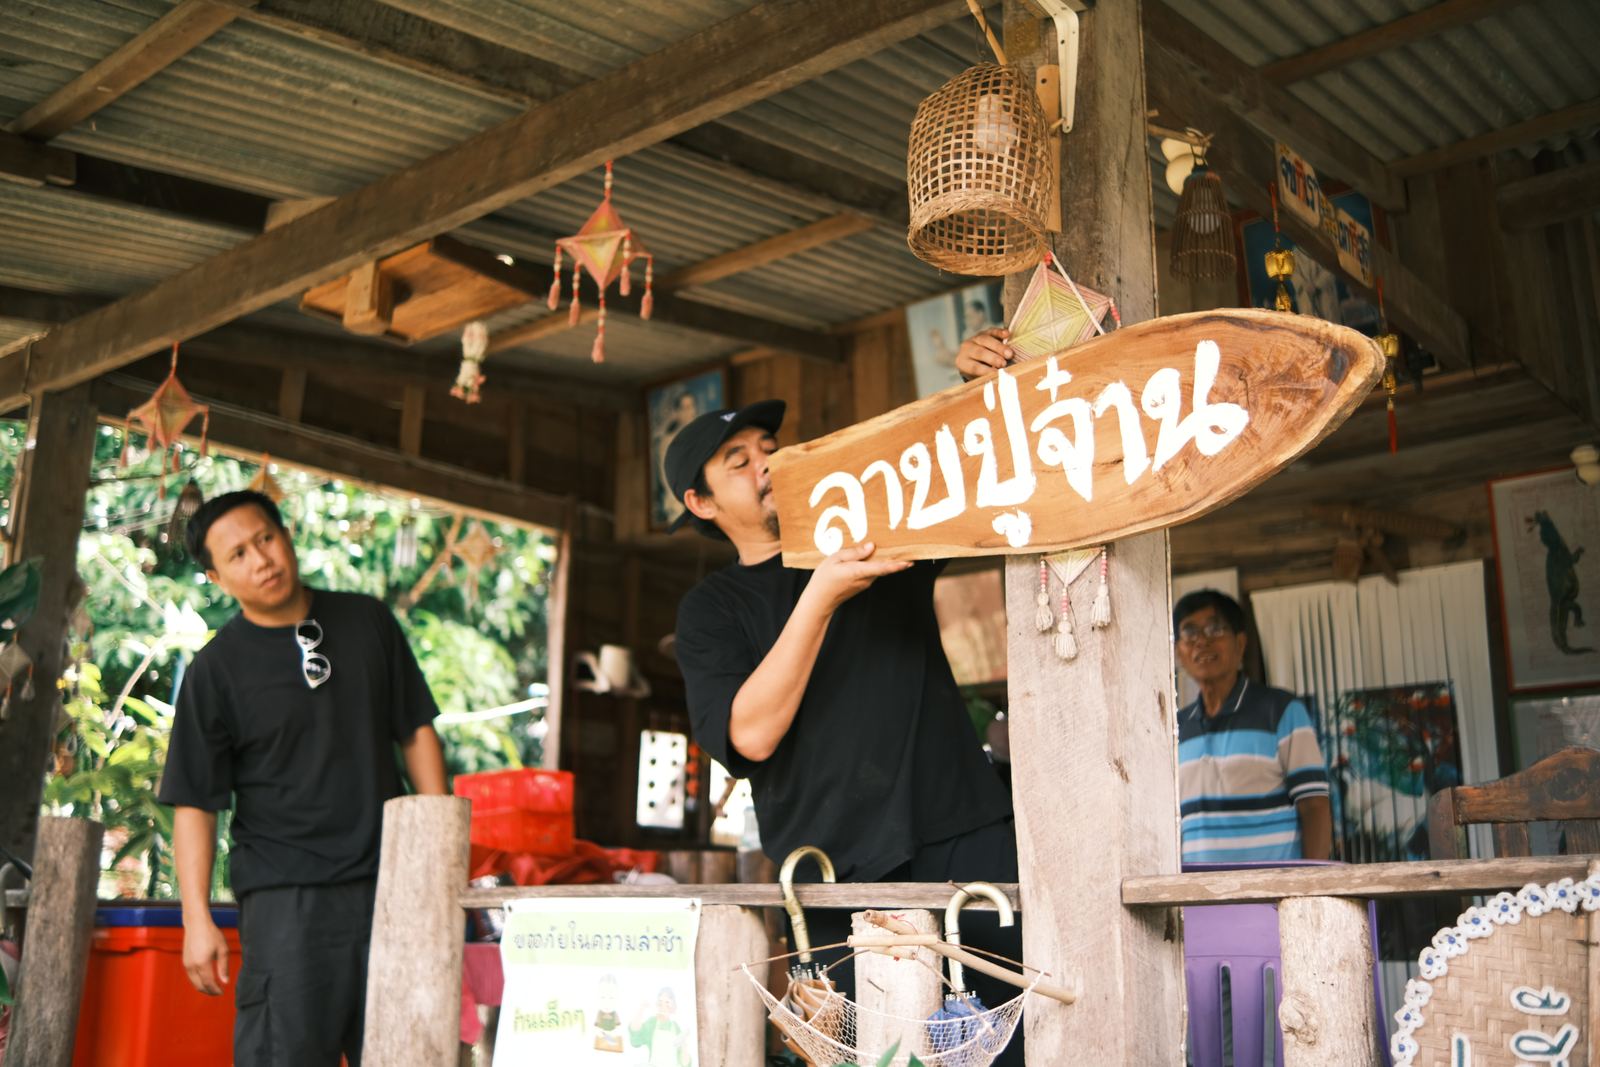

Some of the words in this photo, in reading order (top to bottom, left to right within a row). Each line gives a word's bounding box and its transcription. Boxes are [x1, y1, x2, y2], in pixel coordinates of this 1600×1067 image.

[514, 920, 683, 952] ขออภัยในความล่าช้า
